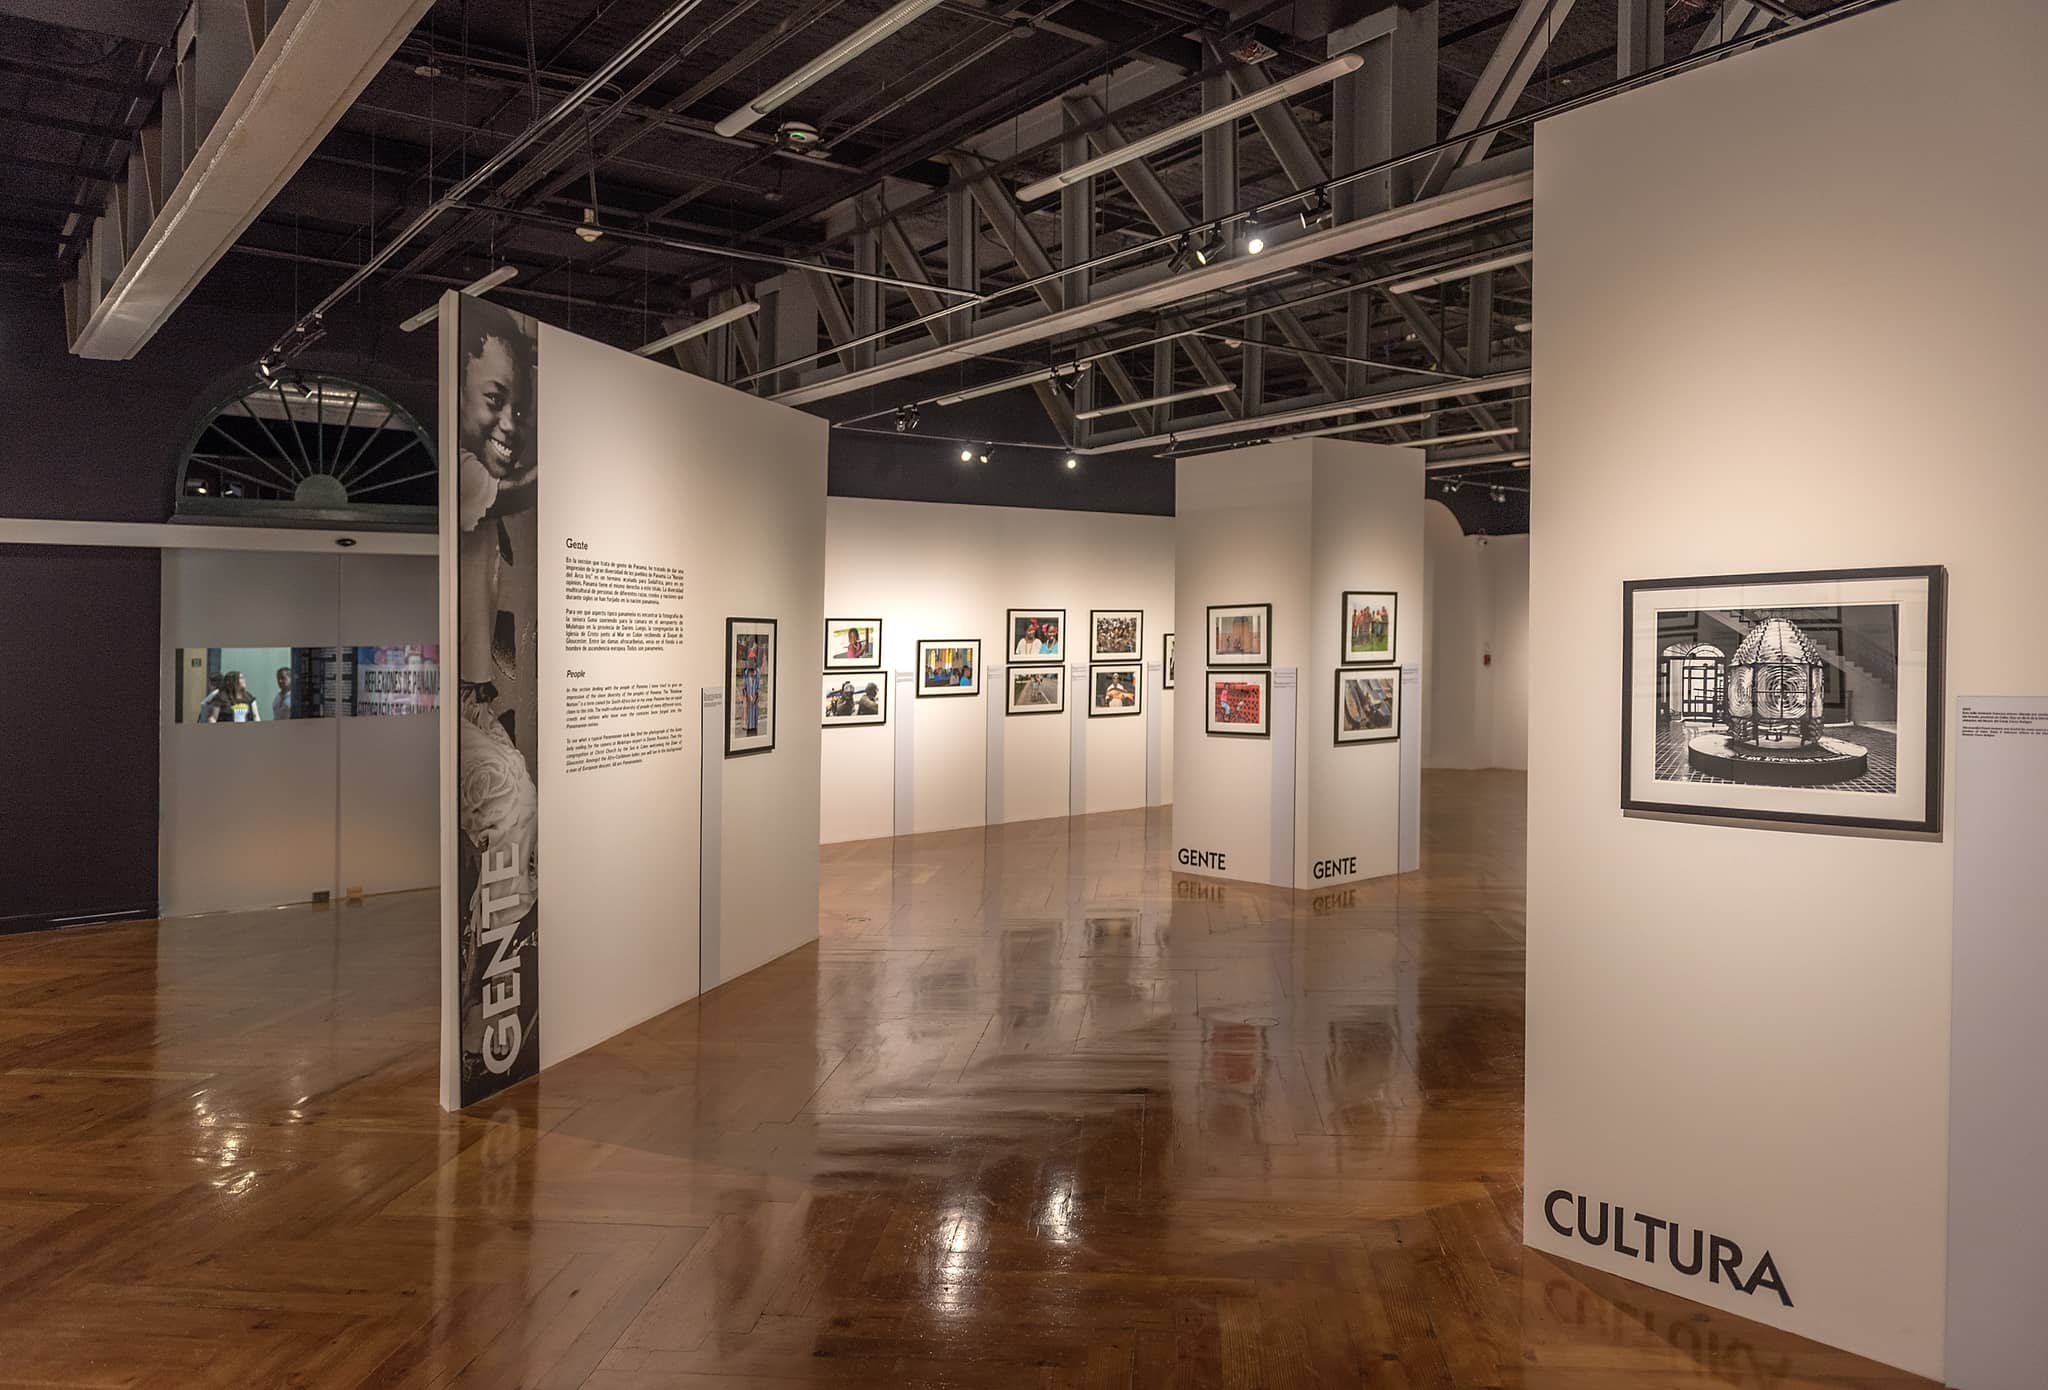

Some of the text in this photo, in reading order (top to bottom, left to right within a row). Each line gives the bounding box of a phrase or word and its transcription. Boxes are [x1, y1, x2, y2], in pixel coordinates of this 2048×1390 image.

[566, 538, 588, 550] Gente
[566, 670, 586, 680] People
[1178, 848, 1226, 870] GENTE
[1313, 856, 1357, 880] GENTE
[482, 843, 522, 1075] GENTE
[1544, 1189, 1794, 1308] CULTURA
